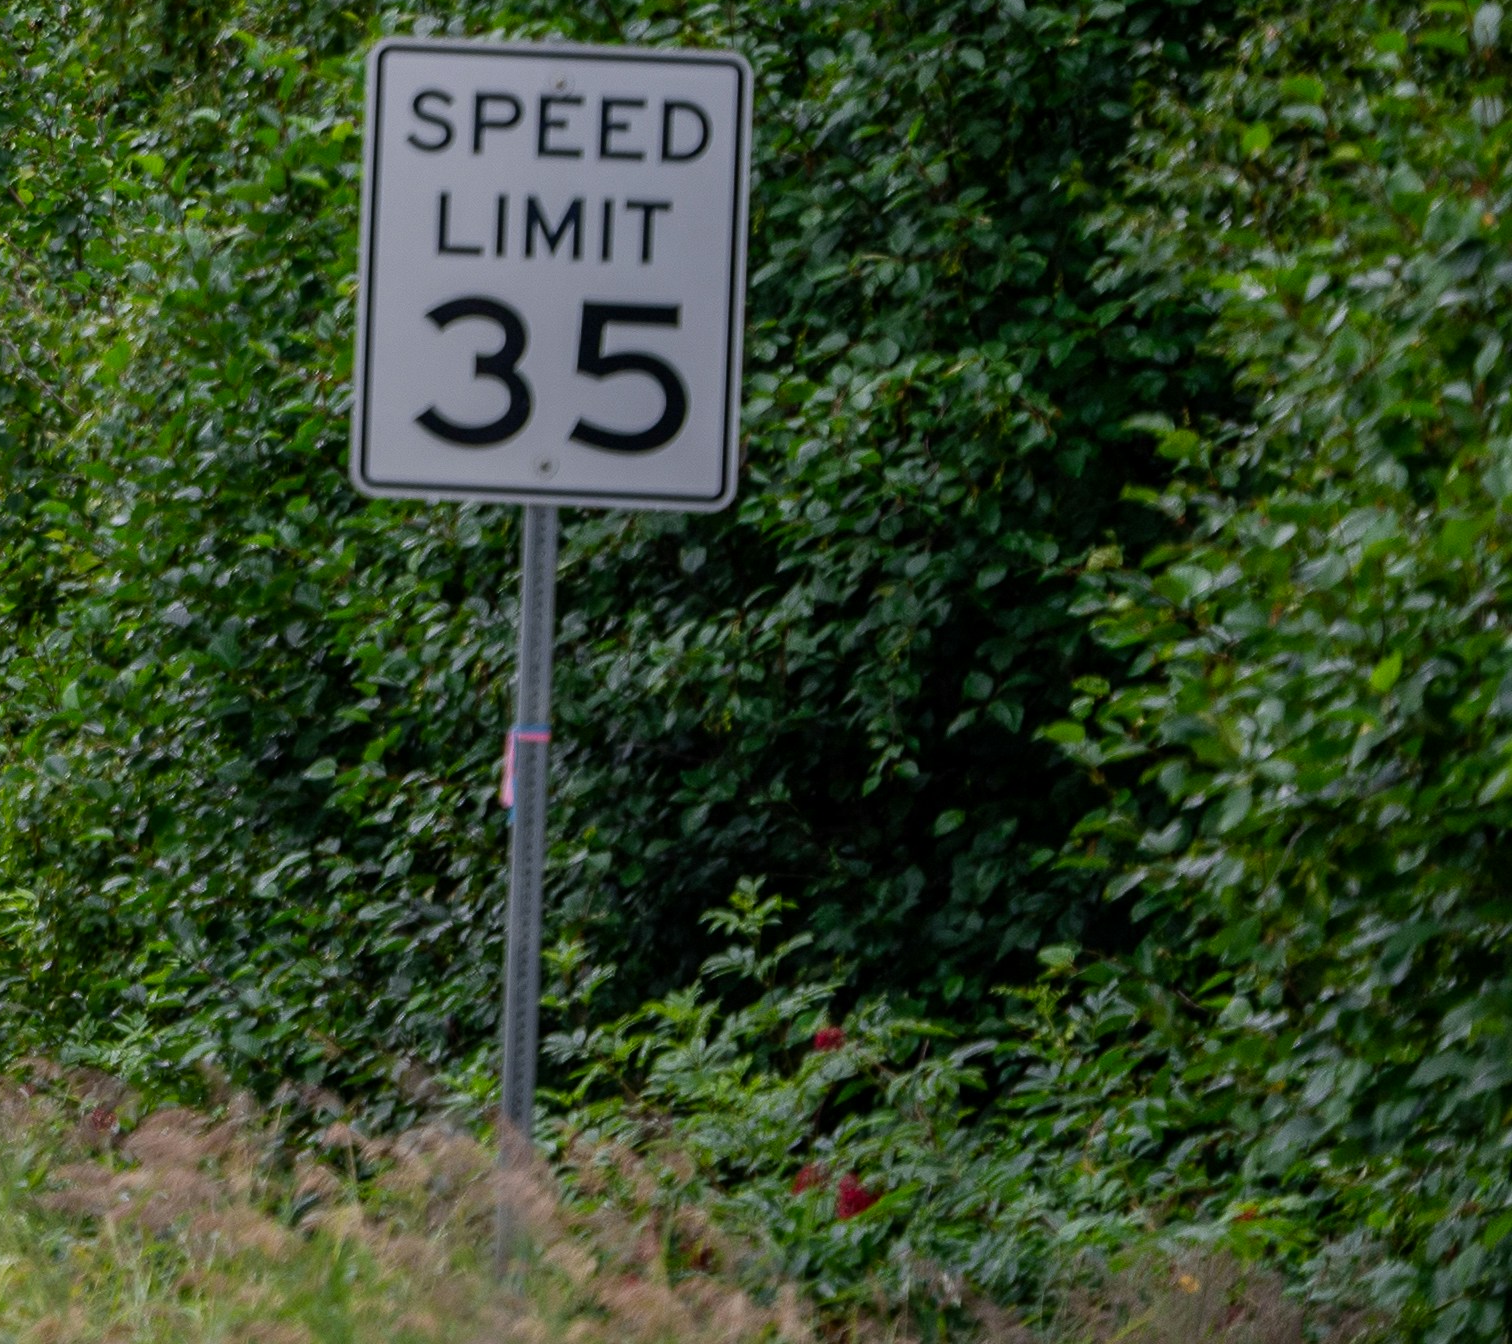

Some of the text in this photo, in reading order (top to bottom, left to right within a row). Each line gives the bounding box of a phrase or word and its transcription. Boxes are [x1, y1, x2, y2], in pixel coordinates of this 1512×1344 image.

[406, 89, 713, 164] SPEED
[437, 191, 673, 265] LIMIT
[413, 294, 691, 457] 35
